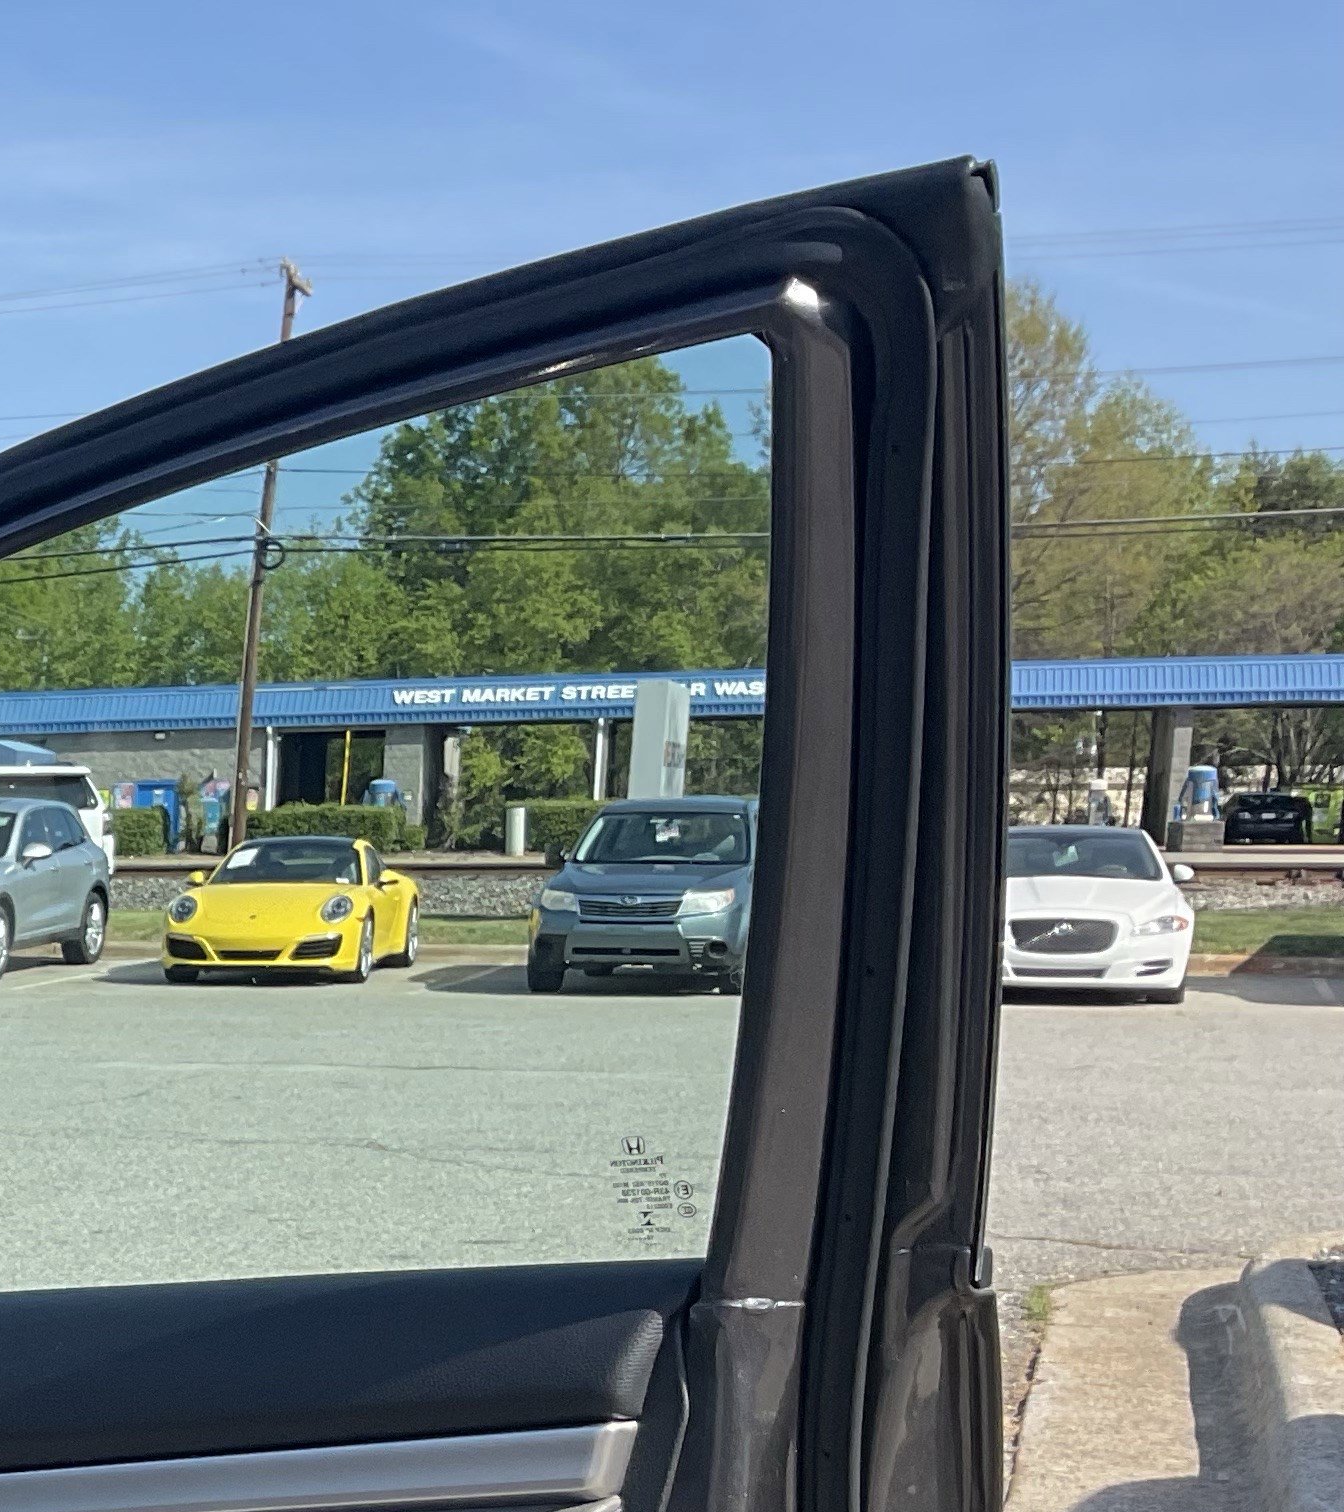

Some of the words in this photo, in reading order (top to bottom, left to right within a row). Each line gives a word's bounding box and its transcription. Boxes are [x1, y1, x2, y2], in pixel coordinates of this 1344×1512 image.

[393, 689, 456, 705] WEST
[461, 686, 556, 703] MARKET
[562, 684, 638, 700] STREE
[714, 681, 766, 696] WAS
